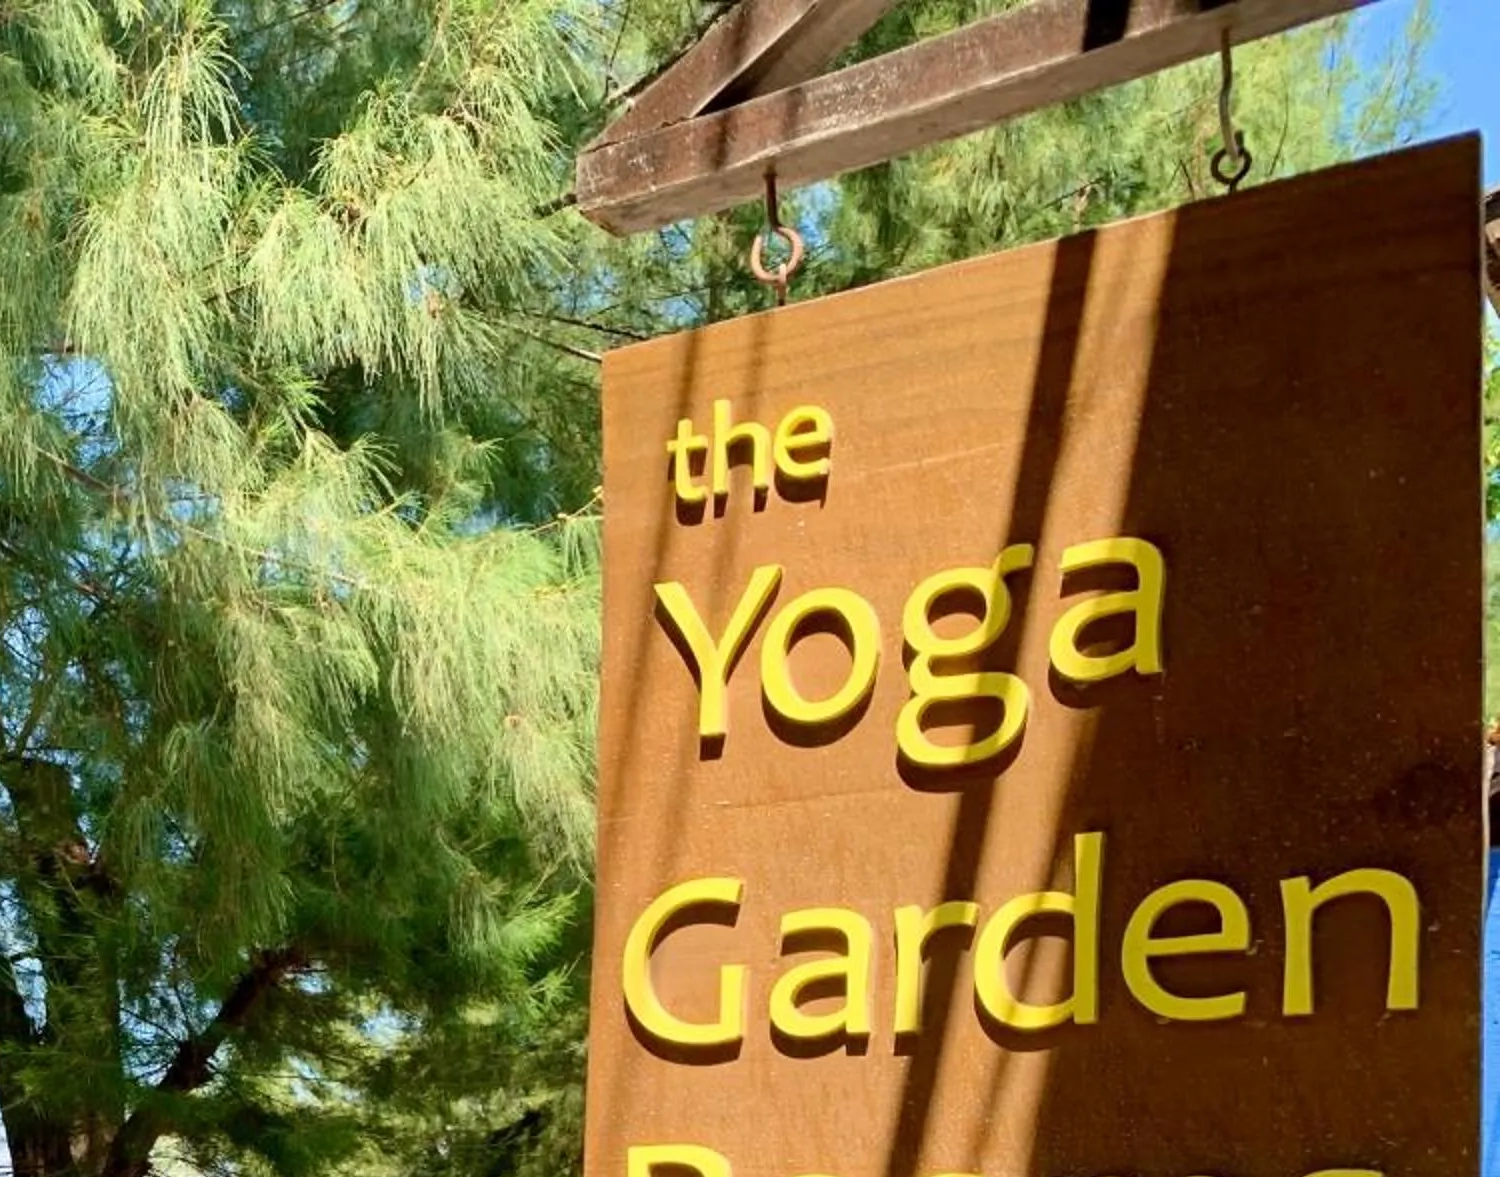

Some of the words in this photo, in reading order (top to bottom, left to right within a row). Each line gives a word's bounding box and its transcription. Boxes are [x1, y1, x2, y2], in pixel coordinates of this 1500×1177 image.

[665, 399, 835, 504] the
[654, 536, 1167, 770] Yoga
[621, 831, 1420, 1047] Garden
